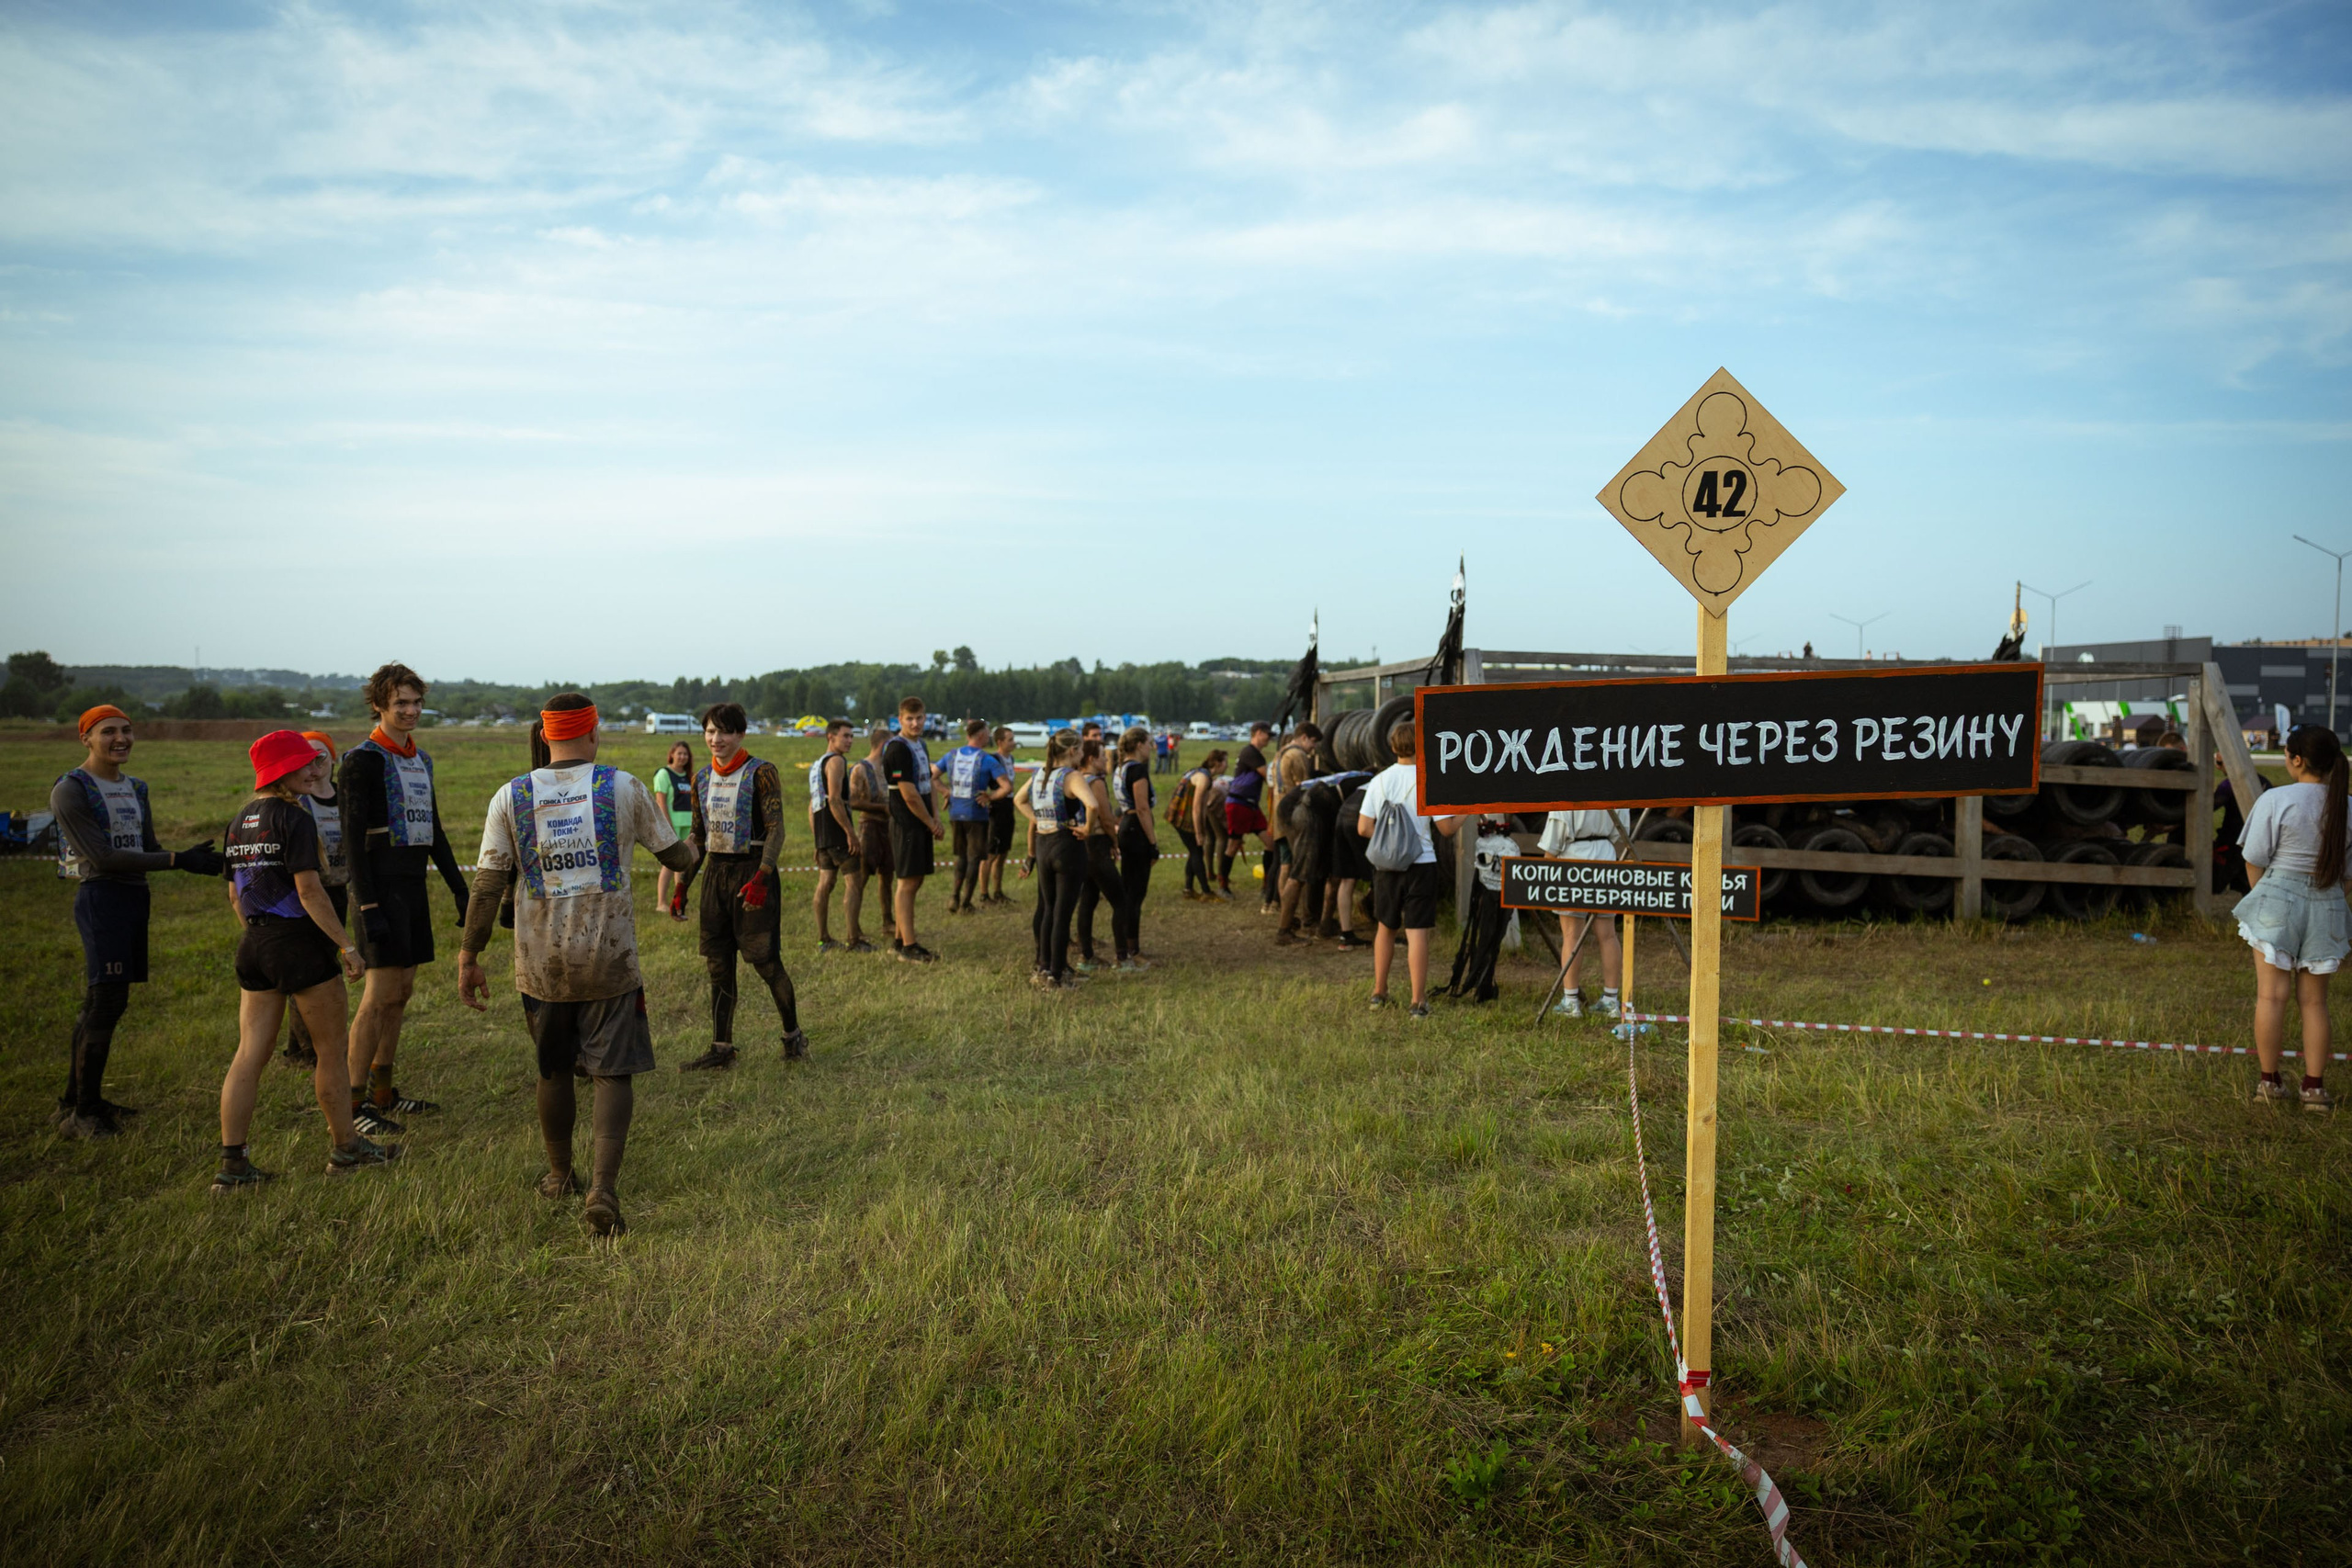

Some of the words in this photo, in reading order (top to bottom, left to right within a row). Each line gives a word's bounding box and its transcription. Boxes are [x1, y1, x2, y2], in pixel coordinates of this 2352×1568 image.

[1692, 469, 1747, 518] 42
[1434, 723, 1685, 774] РОЖДЕНИЕ
[1698, 718, 1838, 767] ЧЕРЕЗ
[1852, 713, 2024, 762] РЕЗИНУ
[539, 797, 561, 806] ГОНКА
[563, 794, 587, 803] ГЕРОЕВ
[547, 816, 582, 829] КОМАНДА
[708, 820, 734, 833] 3802
[552, 827, 579, 837] 10КМ+
[542, 849, 598, 872] 03805
[1511, 864, 1562, 882] КОПИ
[1566, 866, 1675, 887] ОСИНОВЫЕ
[1680, 872, 1747, 890] КЬЯ
[1527, 886, 1540, 902] И
[1544, 886, 1676, 908] СЕРЕБРЯНЫЕ
[1681, 893, 1735, 911] ПИ
[106, 962, 122, 975] 10
